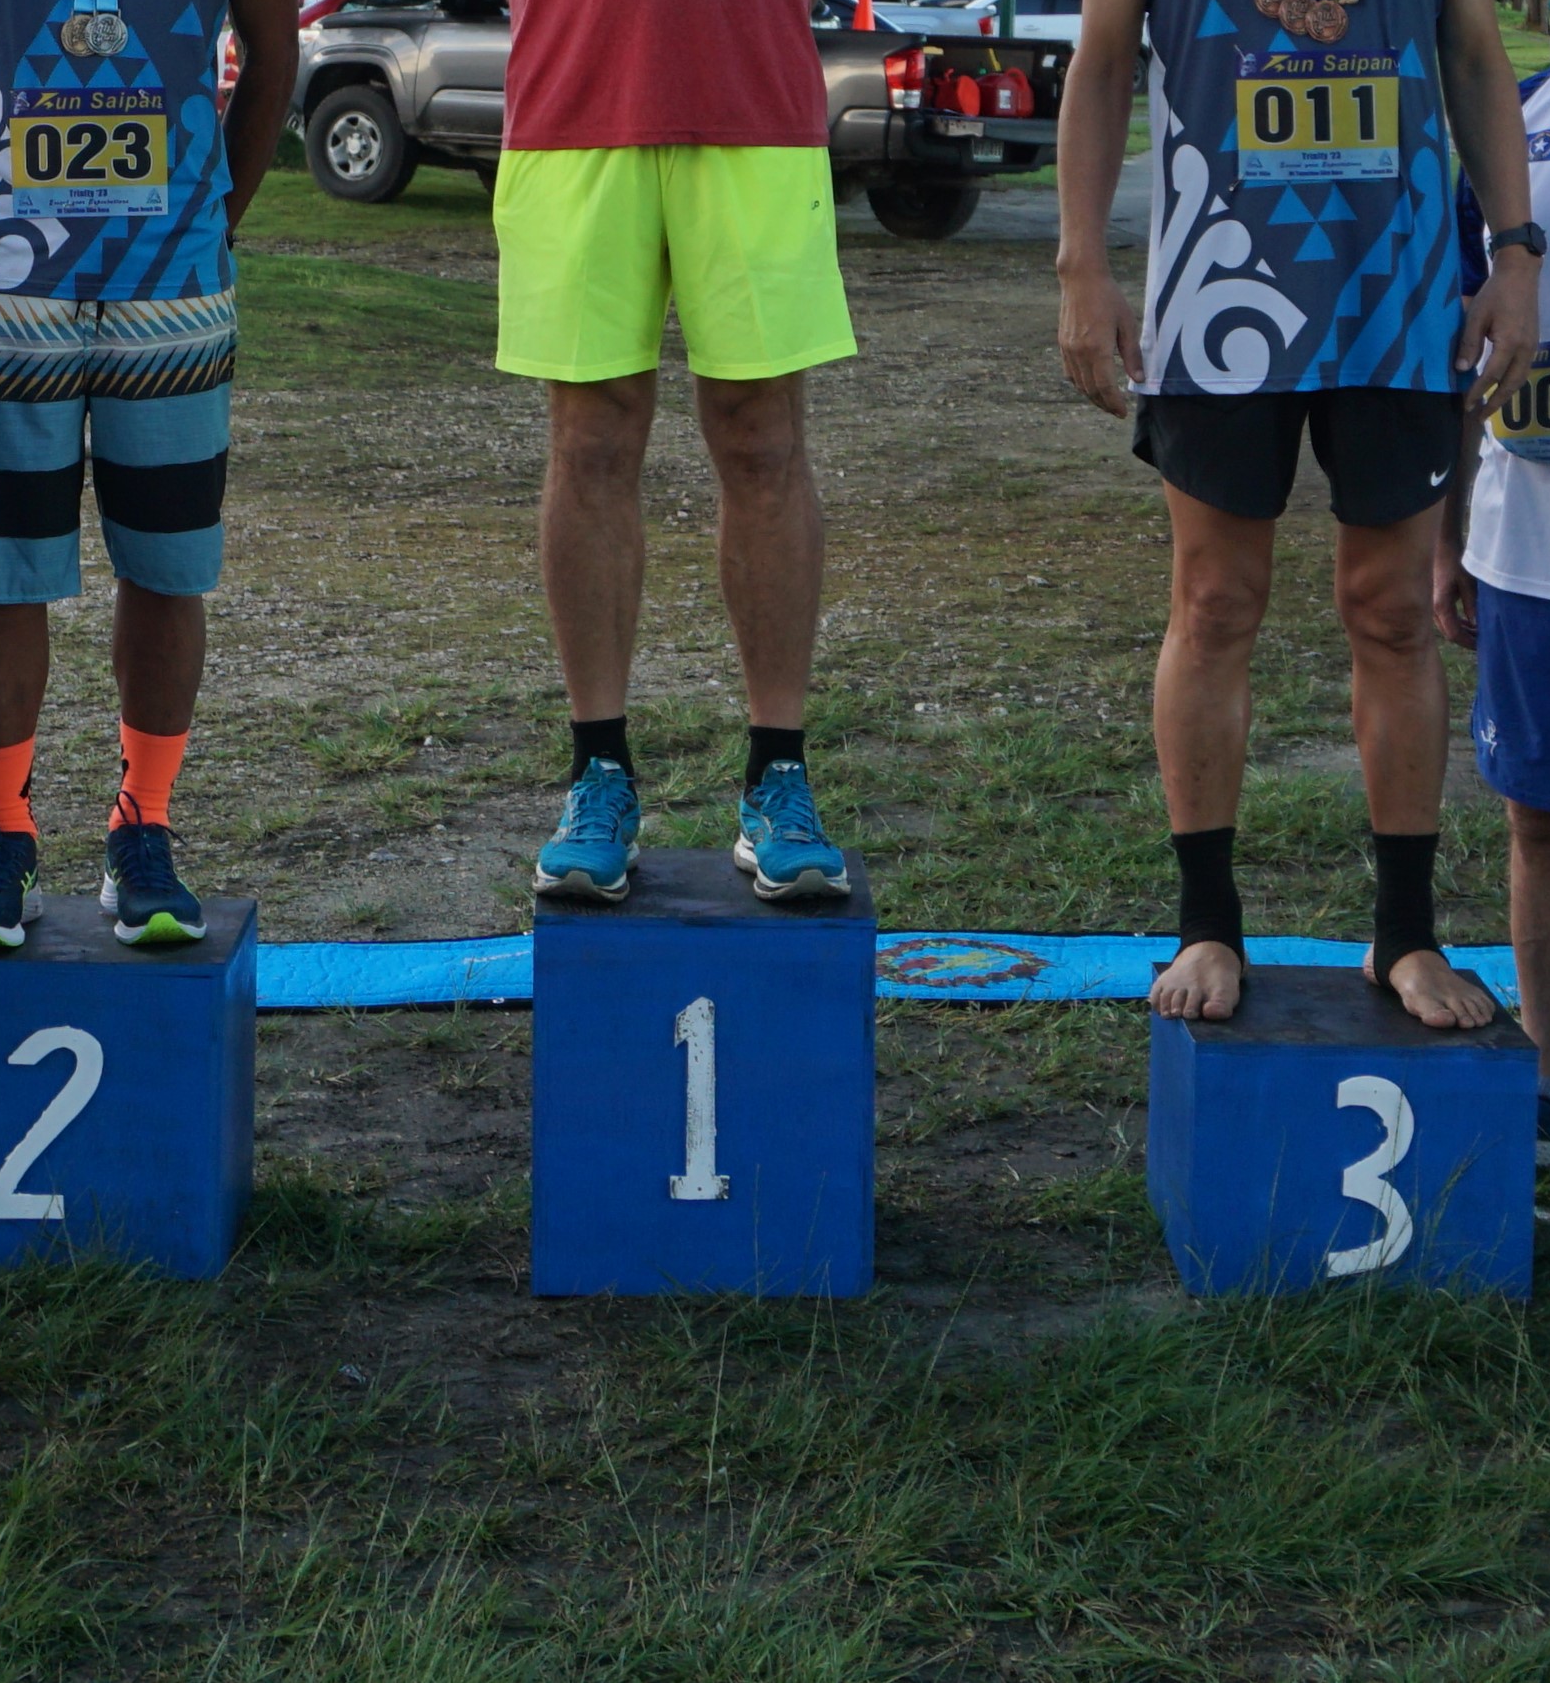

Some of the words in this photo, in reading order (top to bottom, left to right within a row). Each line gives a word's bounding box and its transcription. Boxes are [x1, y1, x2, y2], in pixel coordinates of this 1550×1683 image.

[1323, 53, 1393, 75] Saipan
[90, 91, 163, 113] Saipan
[1254, 84, 1376, 144] 011
[25, 121, 153, 182] 023
[668, 995, 730, 1201] 1
[1326, 1074, 1415, 1278] 3
